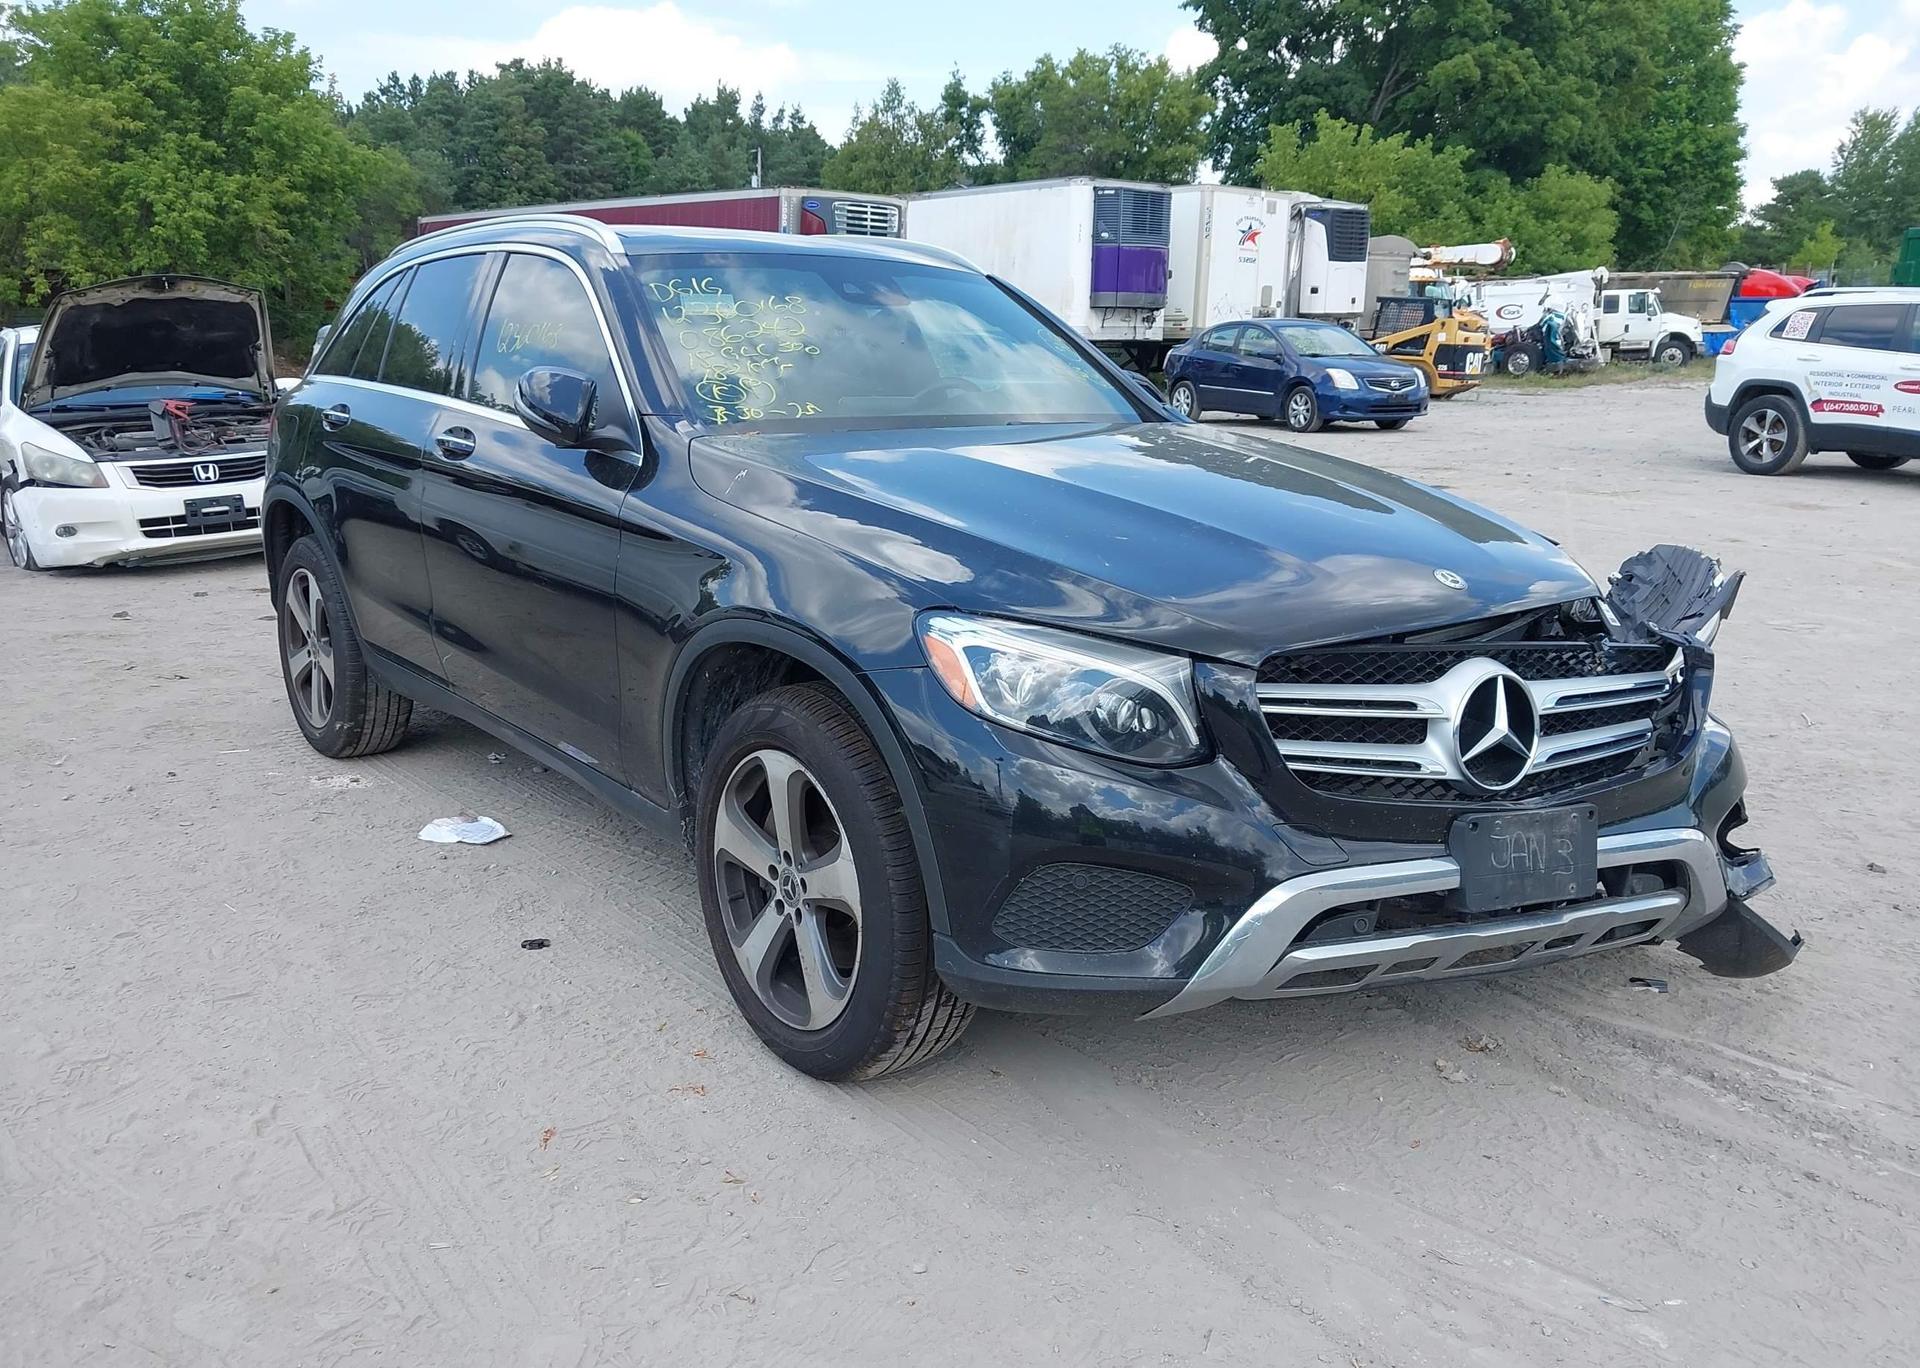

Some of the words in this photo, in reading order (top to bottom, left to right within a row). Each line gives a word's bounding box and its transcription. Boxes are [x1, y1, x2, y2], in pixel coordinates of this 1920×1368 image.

[1465, 352, 1484, 375] CAT
[1489, 831, 1546, 874] JAN
[1552, 838, 1574, 875] 3
